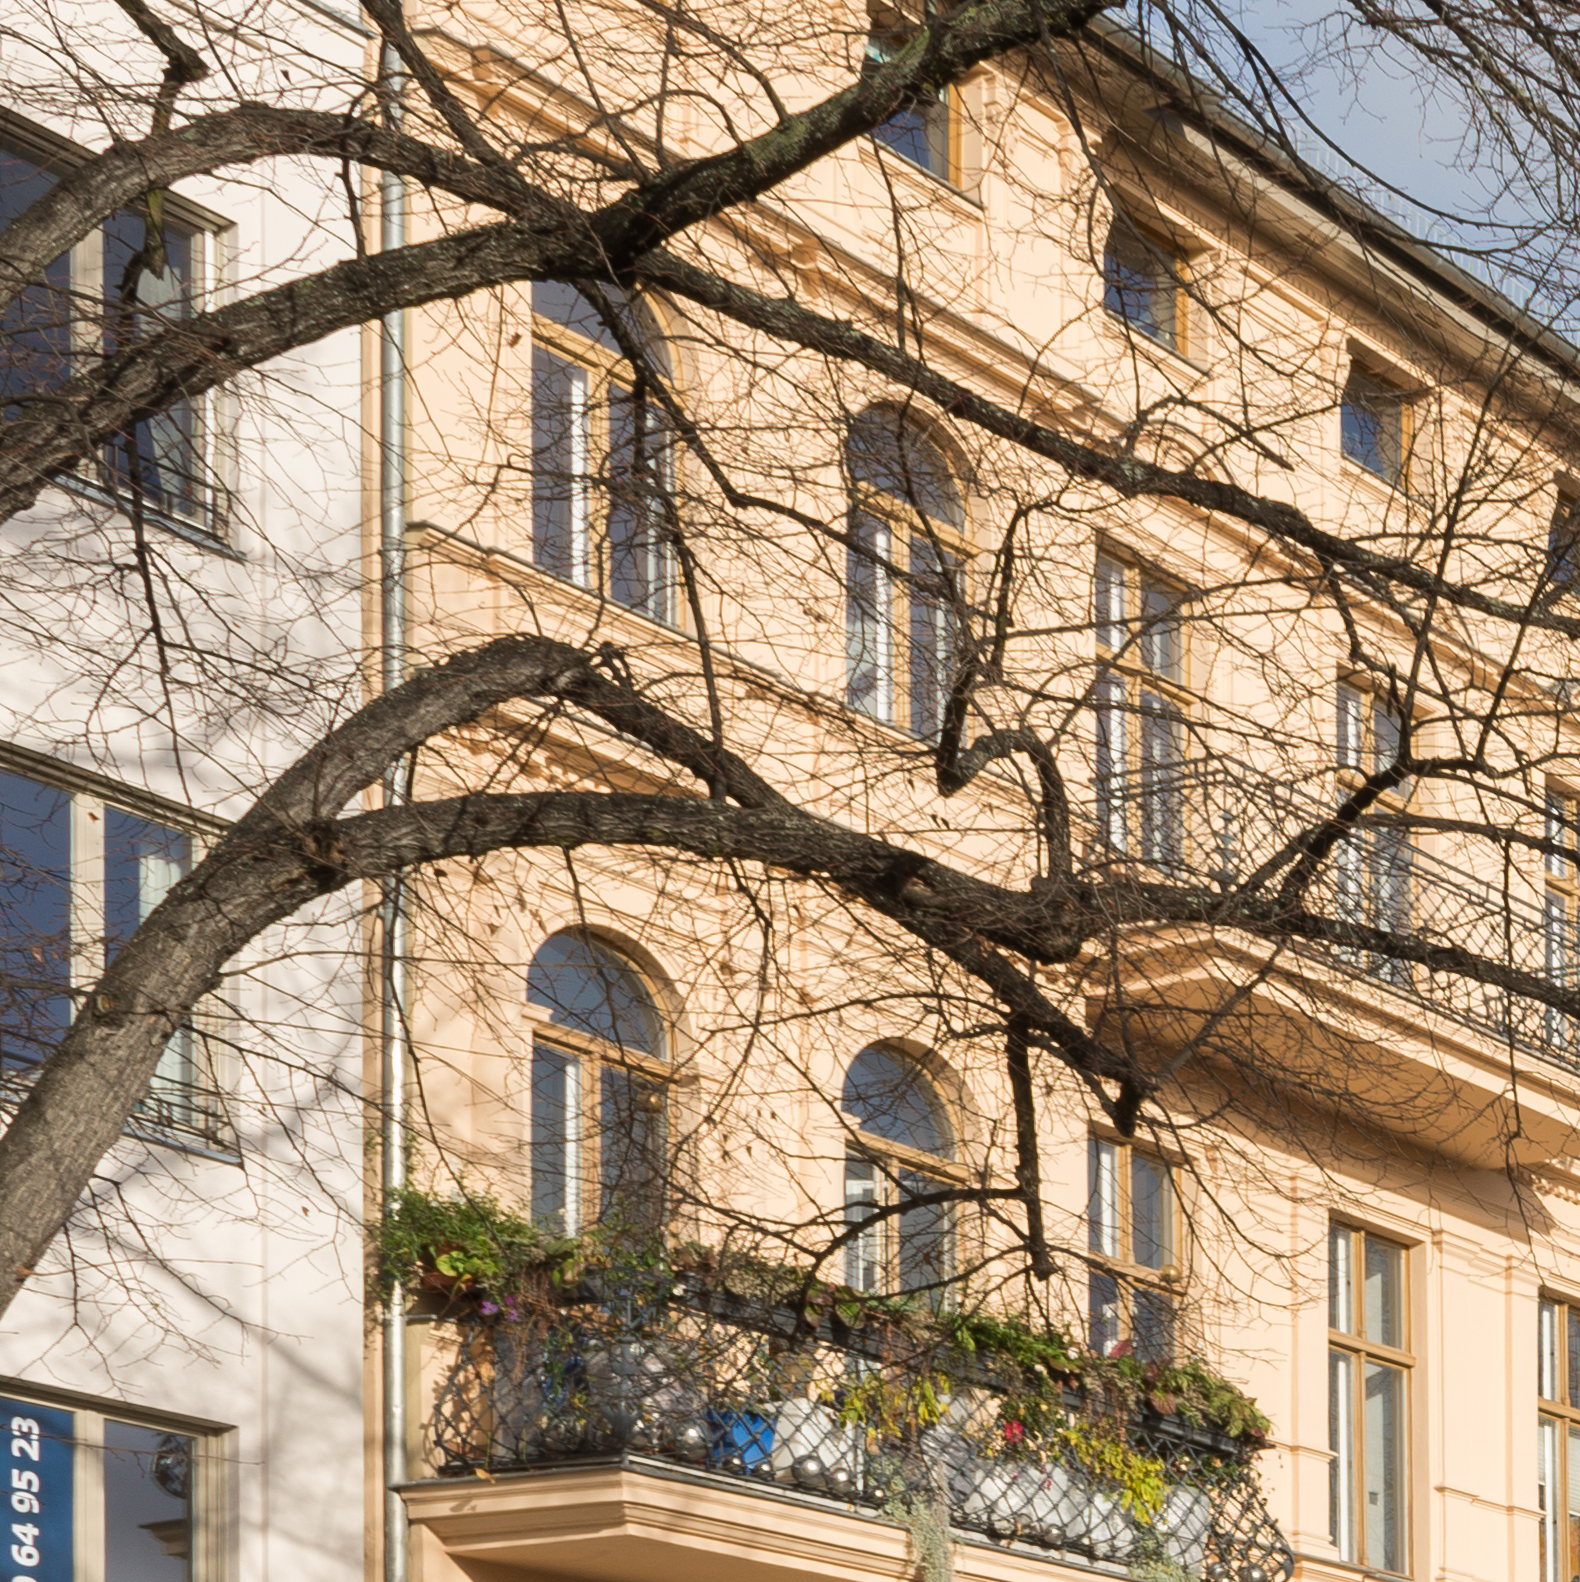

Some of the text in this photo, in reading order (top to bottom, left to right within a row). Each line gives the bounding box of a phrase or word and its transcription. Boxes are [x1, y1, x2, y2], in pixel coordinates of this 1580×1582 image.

[11, 1416, 40, 1461] 23
[11, 1469, 40, 1513] 95
[11, 1523, 40, 1567] 64
